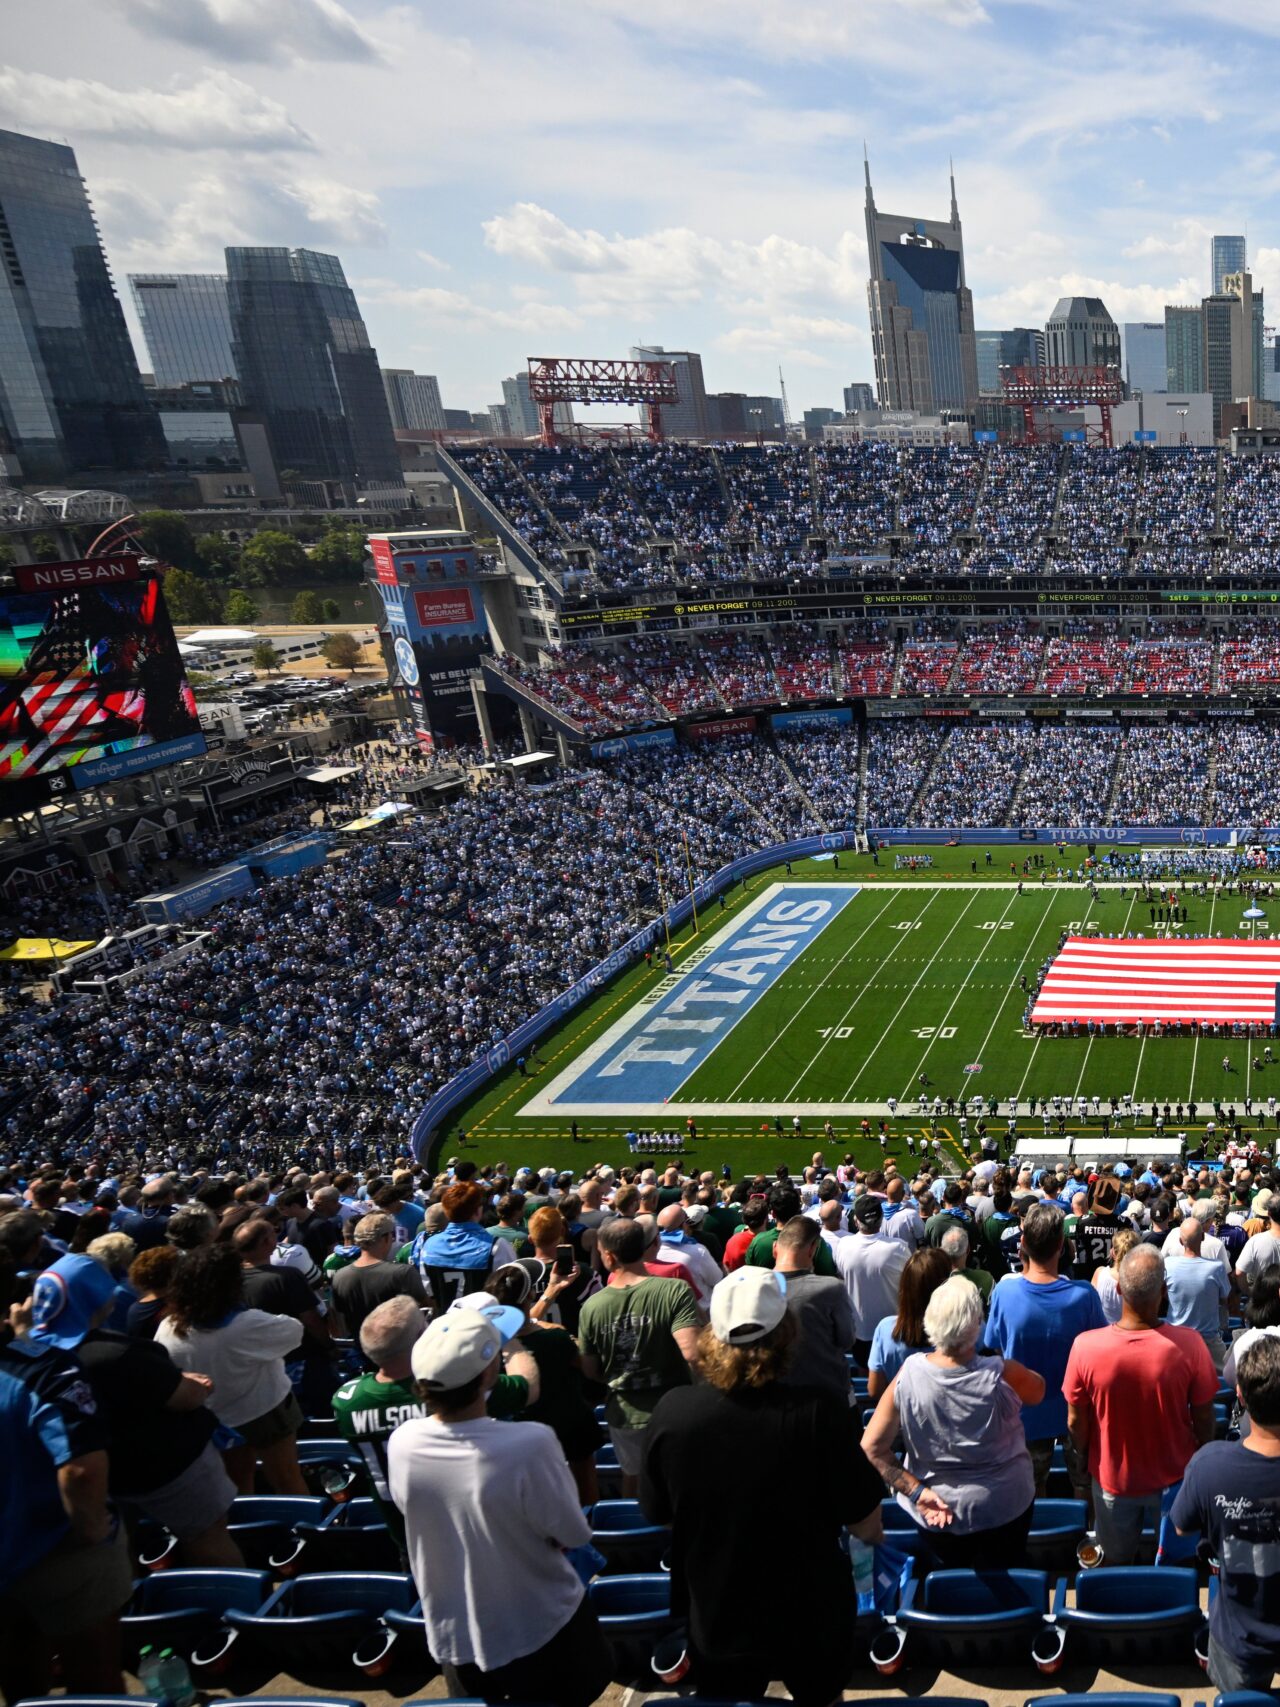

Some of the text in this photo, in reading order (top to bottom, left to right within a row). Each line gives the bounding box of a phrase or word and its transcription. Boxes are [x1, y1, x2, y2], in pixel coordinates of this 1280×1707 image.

[34, 563, 126, 585] NISSAN
[875, 595, 901, 603] NEVER
[902, 594, 932, 602] FORGET
[425, 607, 467, 617] INSURANCE
[687, 604, 715, 613] NEVER
[716, 602, 749, 610] FORGET
[430, 672, 447, 681] WE
[433, 686, 470, 696] TENNESS
[699, 721, 748, 733] NISSAN
[787, 716, 838, 727] TITANS
[1049, 829, 1127, 840] TITAN UP
[640, 945, 716, 1005] NEVER FORGET
[596, 899, 832, 1077] TITANS
[821, 1027, 855, 1038] 10
[917, 1027, 958, 1038] 20
[1084, 1225, 1118, 1235] PETERSON
[351, 1402, 427, 1435] WILSON
[1214, 1494, 1253, 1513] Pacific
